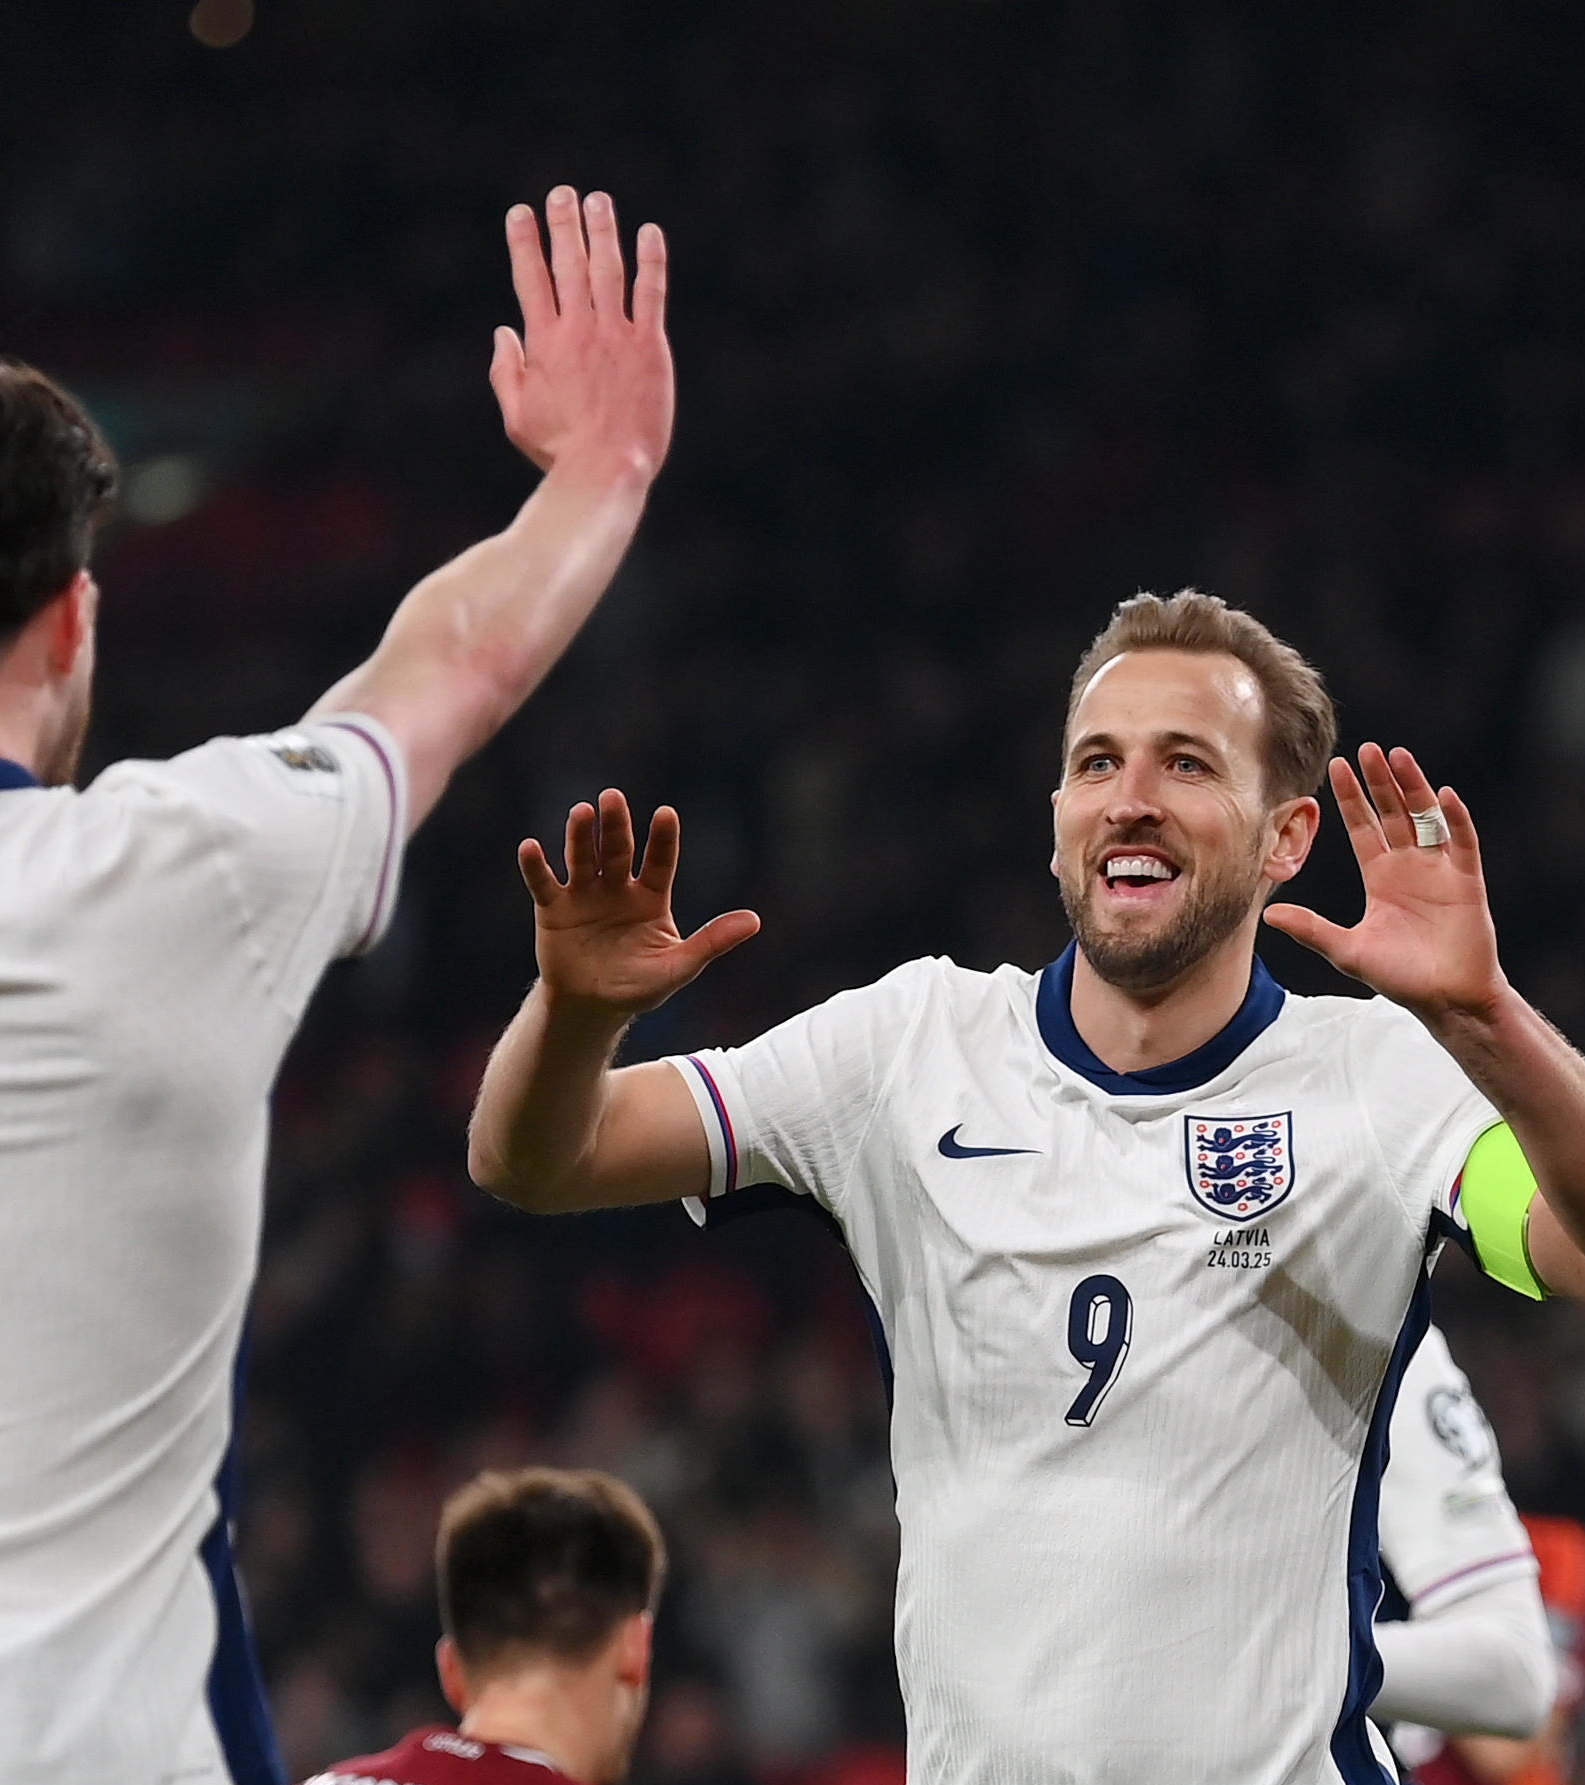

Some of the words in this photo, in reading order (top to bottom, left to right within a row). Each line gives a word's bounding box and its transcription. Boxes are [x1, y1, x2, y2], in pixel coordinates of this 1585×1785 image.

[1213, 1228, 1270, 1247] LATVIA
[1207, 1249, 1273, 1270] 24.03.25
[1064, 1273, 1134, 1428] 9
